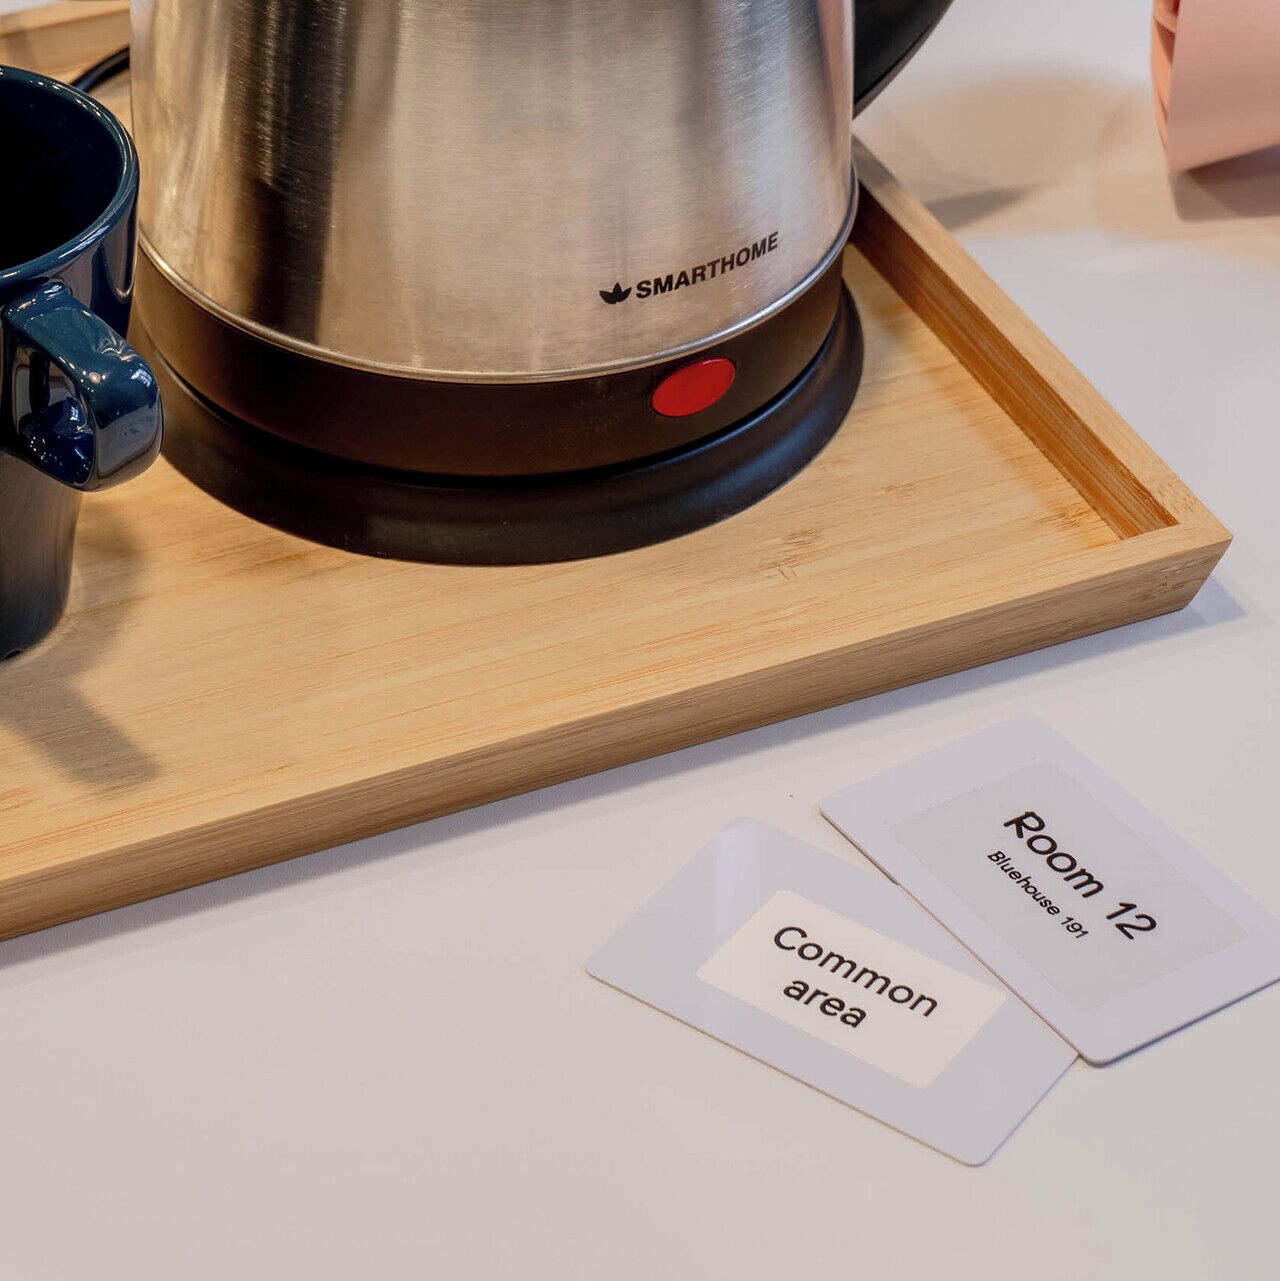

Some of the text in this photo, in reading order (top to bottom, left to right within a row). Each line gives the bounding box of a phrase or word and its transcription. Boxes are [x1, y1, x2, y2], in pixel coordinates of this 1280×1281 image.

[636, 231, 779, 299] SMARTHOME
[987, 850, 1090, 941] Bluehouse 191
[1004, 811, 1158, 942] Room 12
[773, 925, 939, 1018] Common
[782, 976, 868, 1030] area
